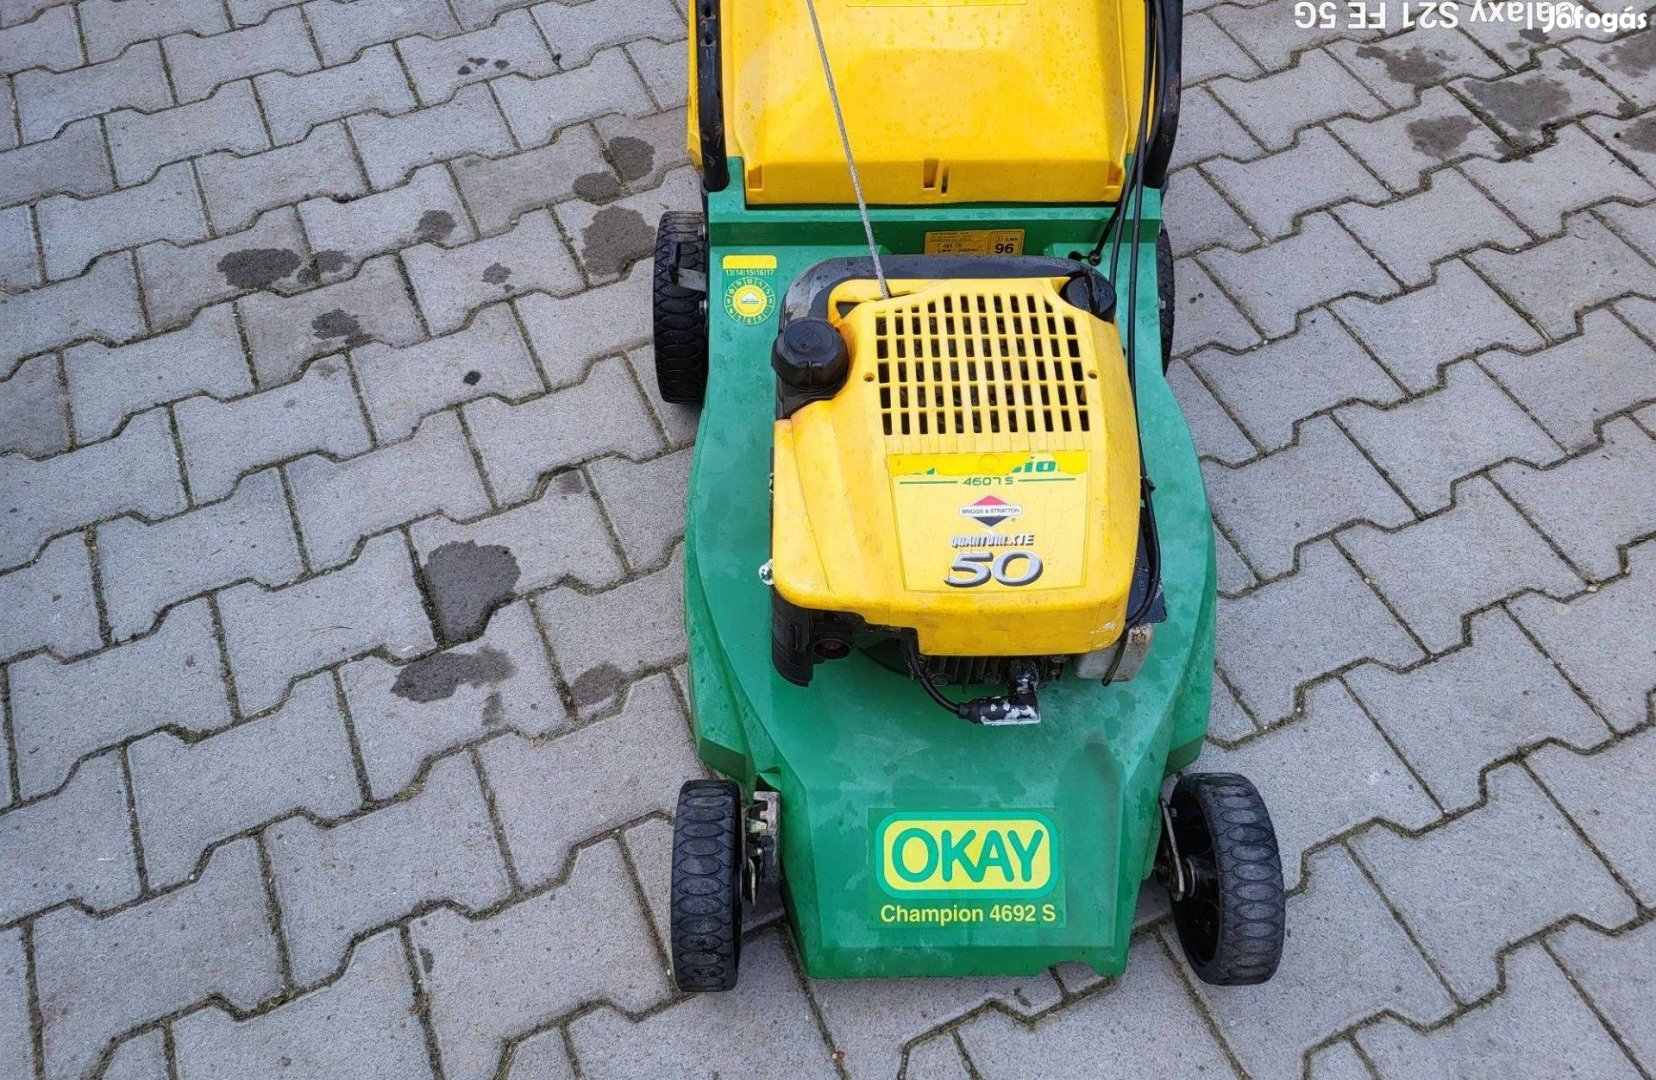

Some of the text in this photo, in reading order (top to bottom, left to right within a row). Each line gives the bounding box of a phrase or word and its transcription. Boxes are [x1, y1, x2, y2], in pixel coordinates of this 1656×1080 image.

[994, 243, 1014, 254] 96
[963, 476, 1013, 486] 4607 S
[943, 550, 1044, 588] 50
[892, 828, 1044, 883] OKAY
[880, 904, 1056, 926] Champion 4692 S
